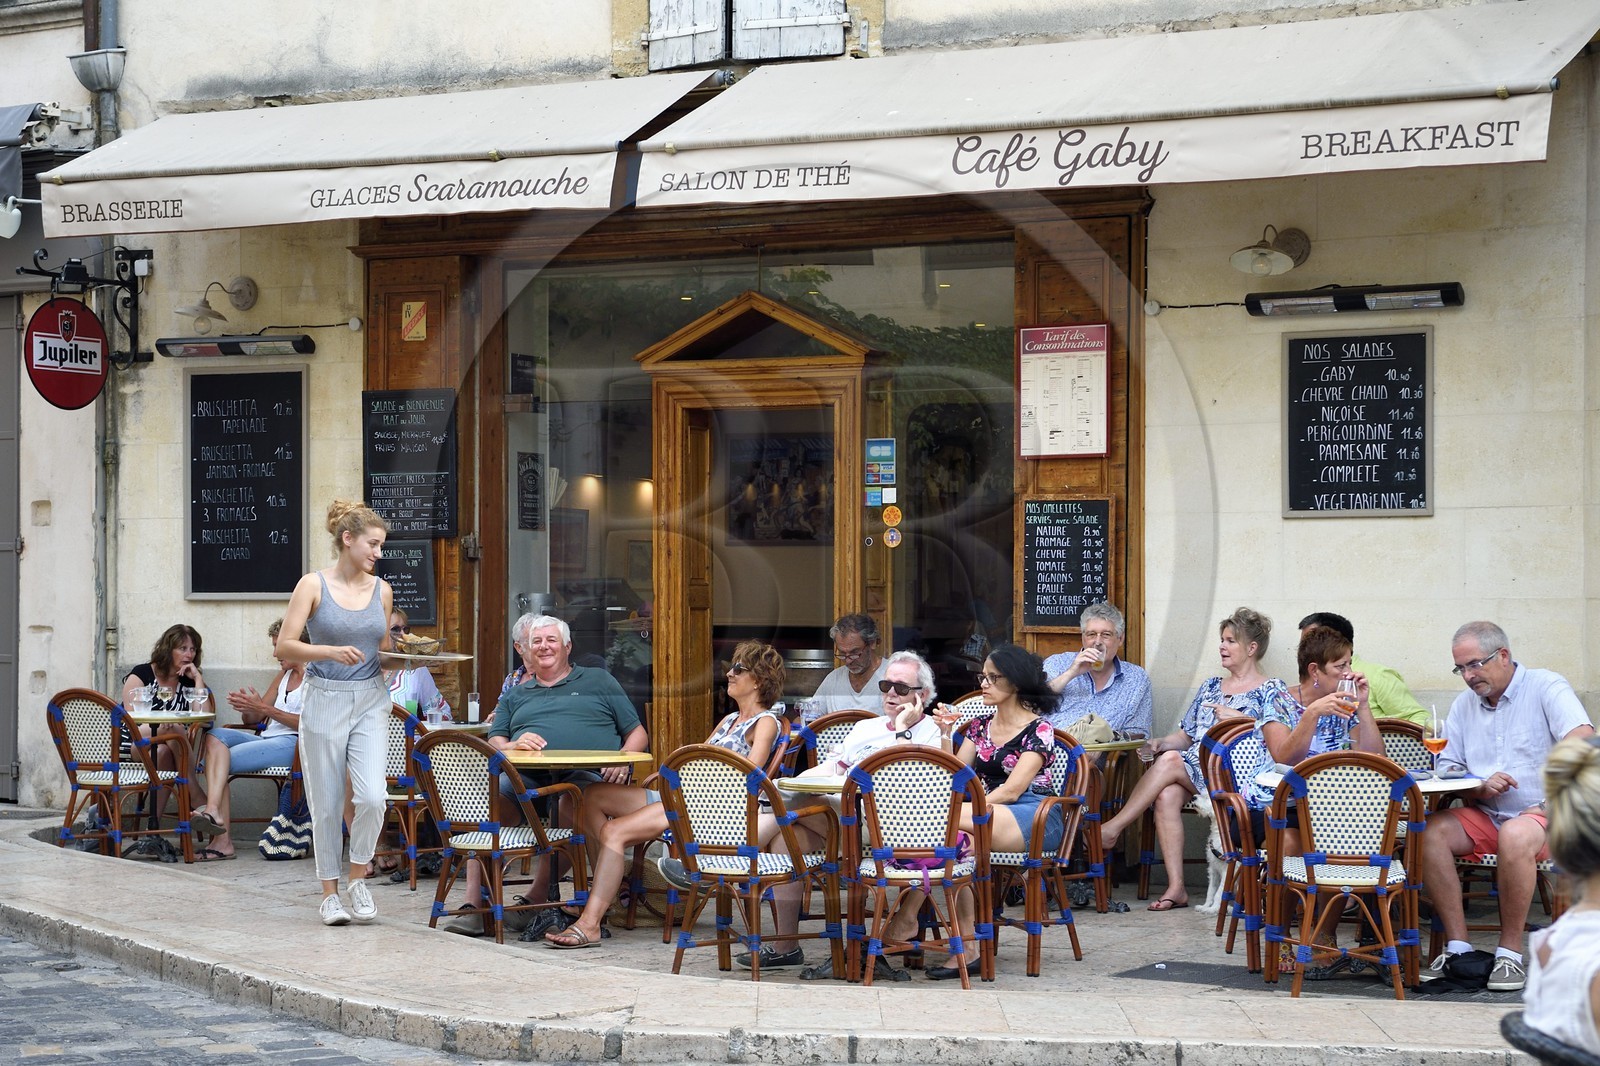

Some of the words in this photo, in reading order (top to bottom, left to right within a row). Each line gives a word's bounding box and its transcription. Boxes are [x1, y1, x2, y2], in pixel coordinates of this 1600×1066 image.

[1300, 120, 1520, 159] BREAKFAST
[952, 132, 1040, 188] Café
[1053, 126, 1170, 186] Gaby
[659, 170, 748, 192] SALON
[753, 169, 790, 189] DE
[797, 160, 850, 187] THÉ
[310, 185, 401, 208] GLACES
[407, 167, 589, 202] Scaramouche
[61, 199, 183, 223] BRASSERIE
[1043, 330, 1071, 343] Tarif
[1070, 330, 1085, 341] des
[1025, 338, 1104, 352] Consommations
[1304, 344, 1330, 360] NOS
[1341, 342, 1394, 358] SALADES
[38, 340, 98, 367] Jupiler
[1321, 366, 1355, 382] GABY
[1302, 386, 1344, 402] CHEVRE
[1352, 385, 1388, 400] CHAUD
[197, 399, 258, 417] BRUSCHETTA
[371, 400, 396, 412] SALADE
[406, 400, 444, 410] BIENVENUE
[222, 418, 268, 434] TAPENADE
[383, 415, 400, 424] PLAT
[408, 414, 426, 424] JOUR
[202, 444, 253, 460] BRUSCHETTA
[1319, 443, 1388, 460] PARMESANE
[1321, 464, 1380, 482] COMPLETE
[202, 487, 254, 504] BRUSCHETTA
[204, 508, 210, 522] 3
[216, 506, 257, 522] FROMAGES
[1026, 503, 1040, 514] NOS
[1043, 503, 1083, 514] OMELETTES
[1072, 515, 1099, 524] SALADE
[202, 528, 251, 544] BRUSCHETTA
[1036, 526, 1066, 536] NATURE
[1035, 537, 1071, 547] FROMAGE
[220, 547, 250, 560] CANARD
[382, 550, 404, 558] ESSERTS
[1035, 550, 1066, 558] CHEVRE
[1036, 562, 1066, 571] TOMATE
[1037, 584, 1064, 593] EPAULE
[1036, 595, 1057, 605] FINES
[1059, 595, 1087, 605] HERBES
[1036, 606, 1078, 615] ROQUEFORT
